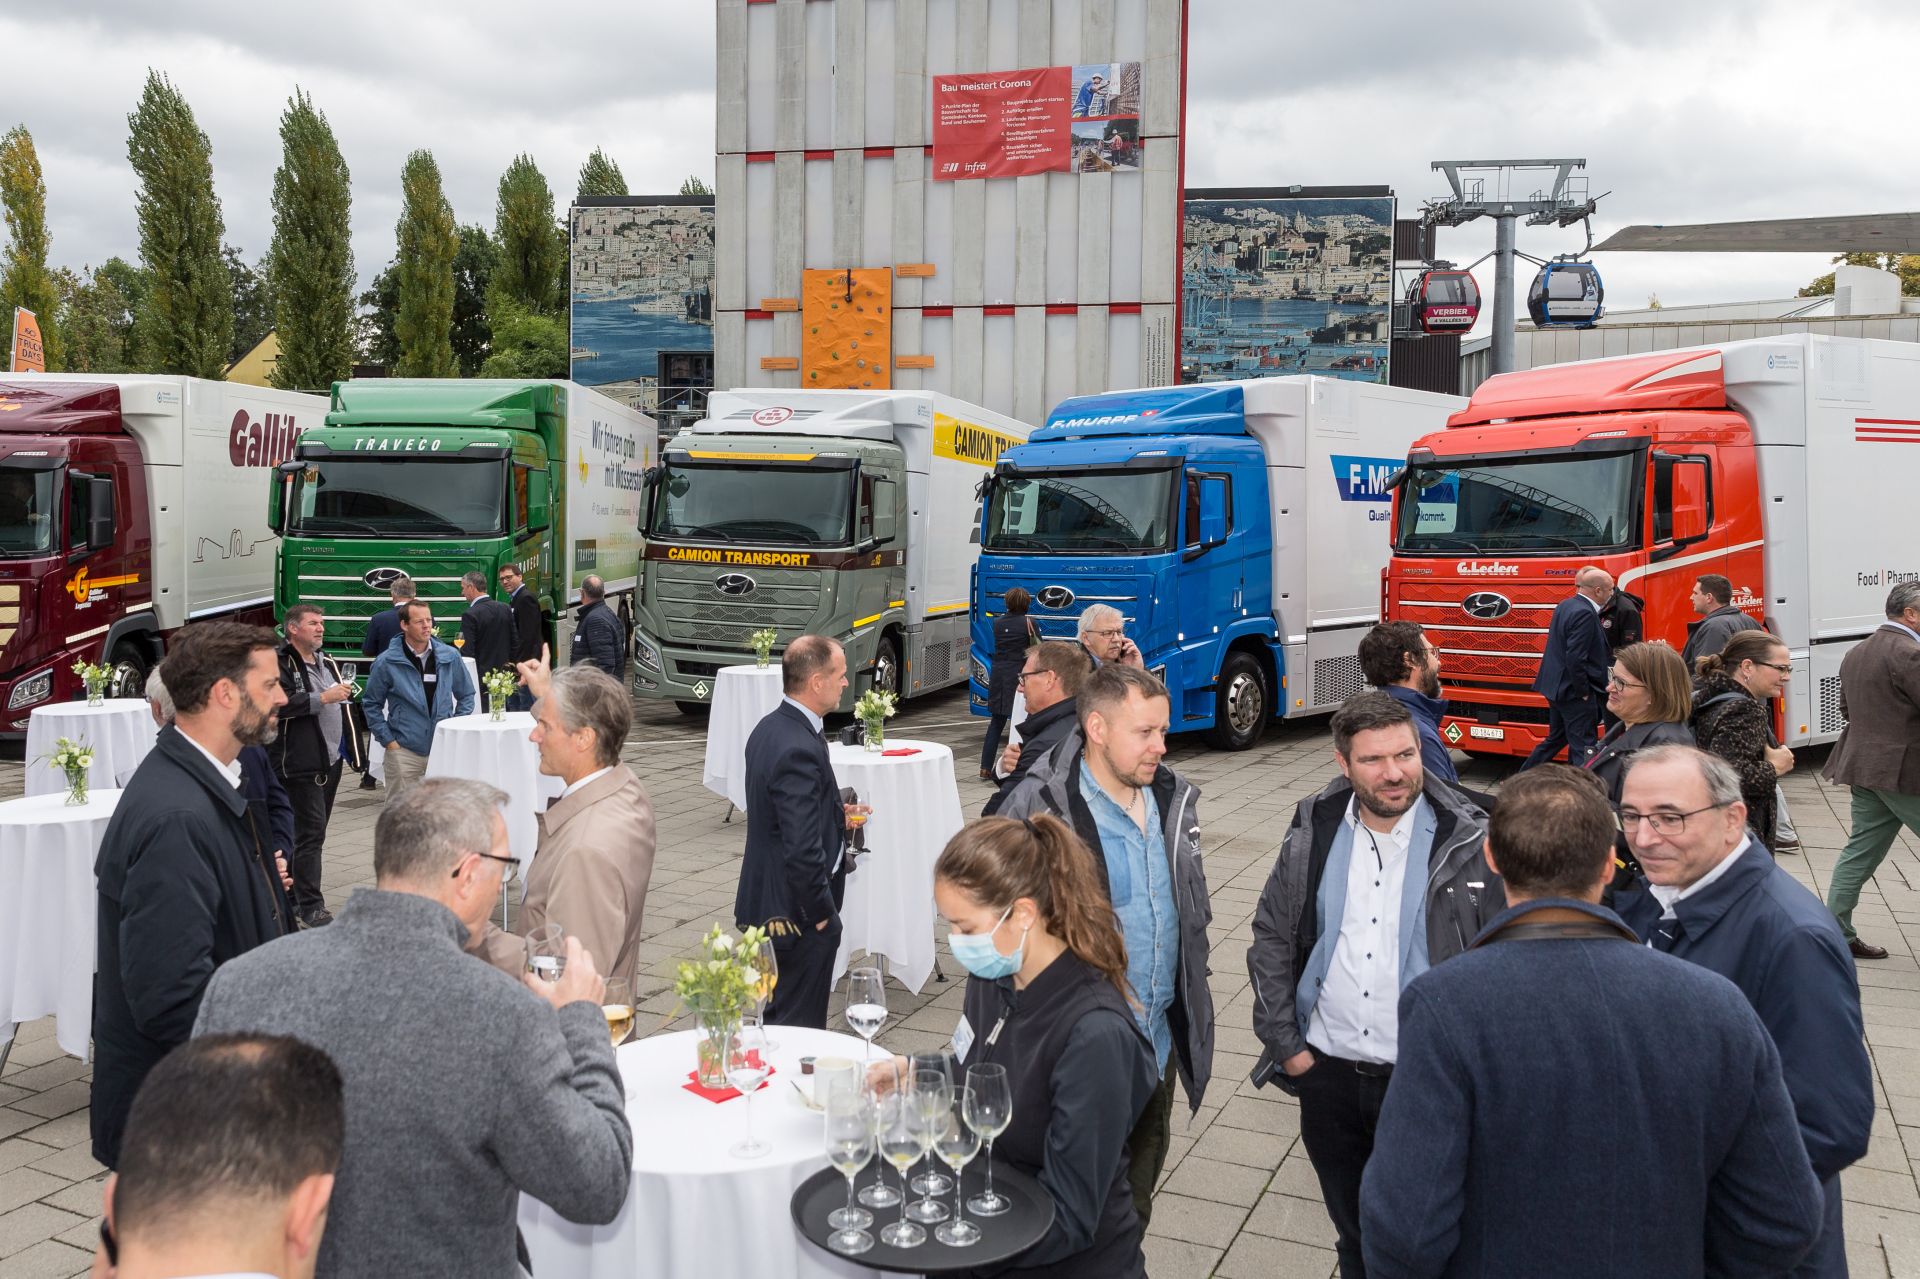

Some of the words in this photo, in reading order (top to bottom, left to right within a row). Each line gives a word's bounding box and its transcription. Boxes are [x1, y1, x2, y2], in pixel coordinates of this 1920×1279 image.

[941, 83, 958, 92] Bau
[960, 81, 998, 91] meistert
[999, 79, 1031, 89] Corona
[965, 161, 987, 173] infra
[1433, 308, 1468, 316] VERBIER
[19, 338, 43, 352] TRUCK
[22, 348, 42, 362] DAYS
[1051, 414, 1139, 430] F.MURPF
[354, 438, 442, 451] TRAVECO
[592, 419, 603, 450] Wir
[603, 423, 622, 459] fahren
[623, 433, 636, 465] grün
[954, 424, 993, 462] CAMION
[604, 460, 615, 488] mit
[1369, 509, 1391, 522] Qualit
[668, 547, 722, 562] CAMION
[725, 550, 812, 567] TRANSPORT
[1456, 562, 1519, 576] G.Leclerc
[1857, 571, 1879, 587] Food
[1887, 569, 1920, 584] Pharma
[1729, 595, 1763, 608] G.Leclerc
